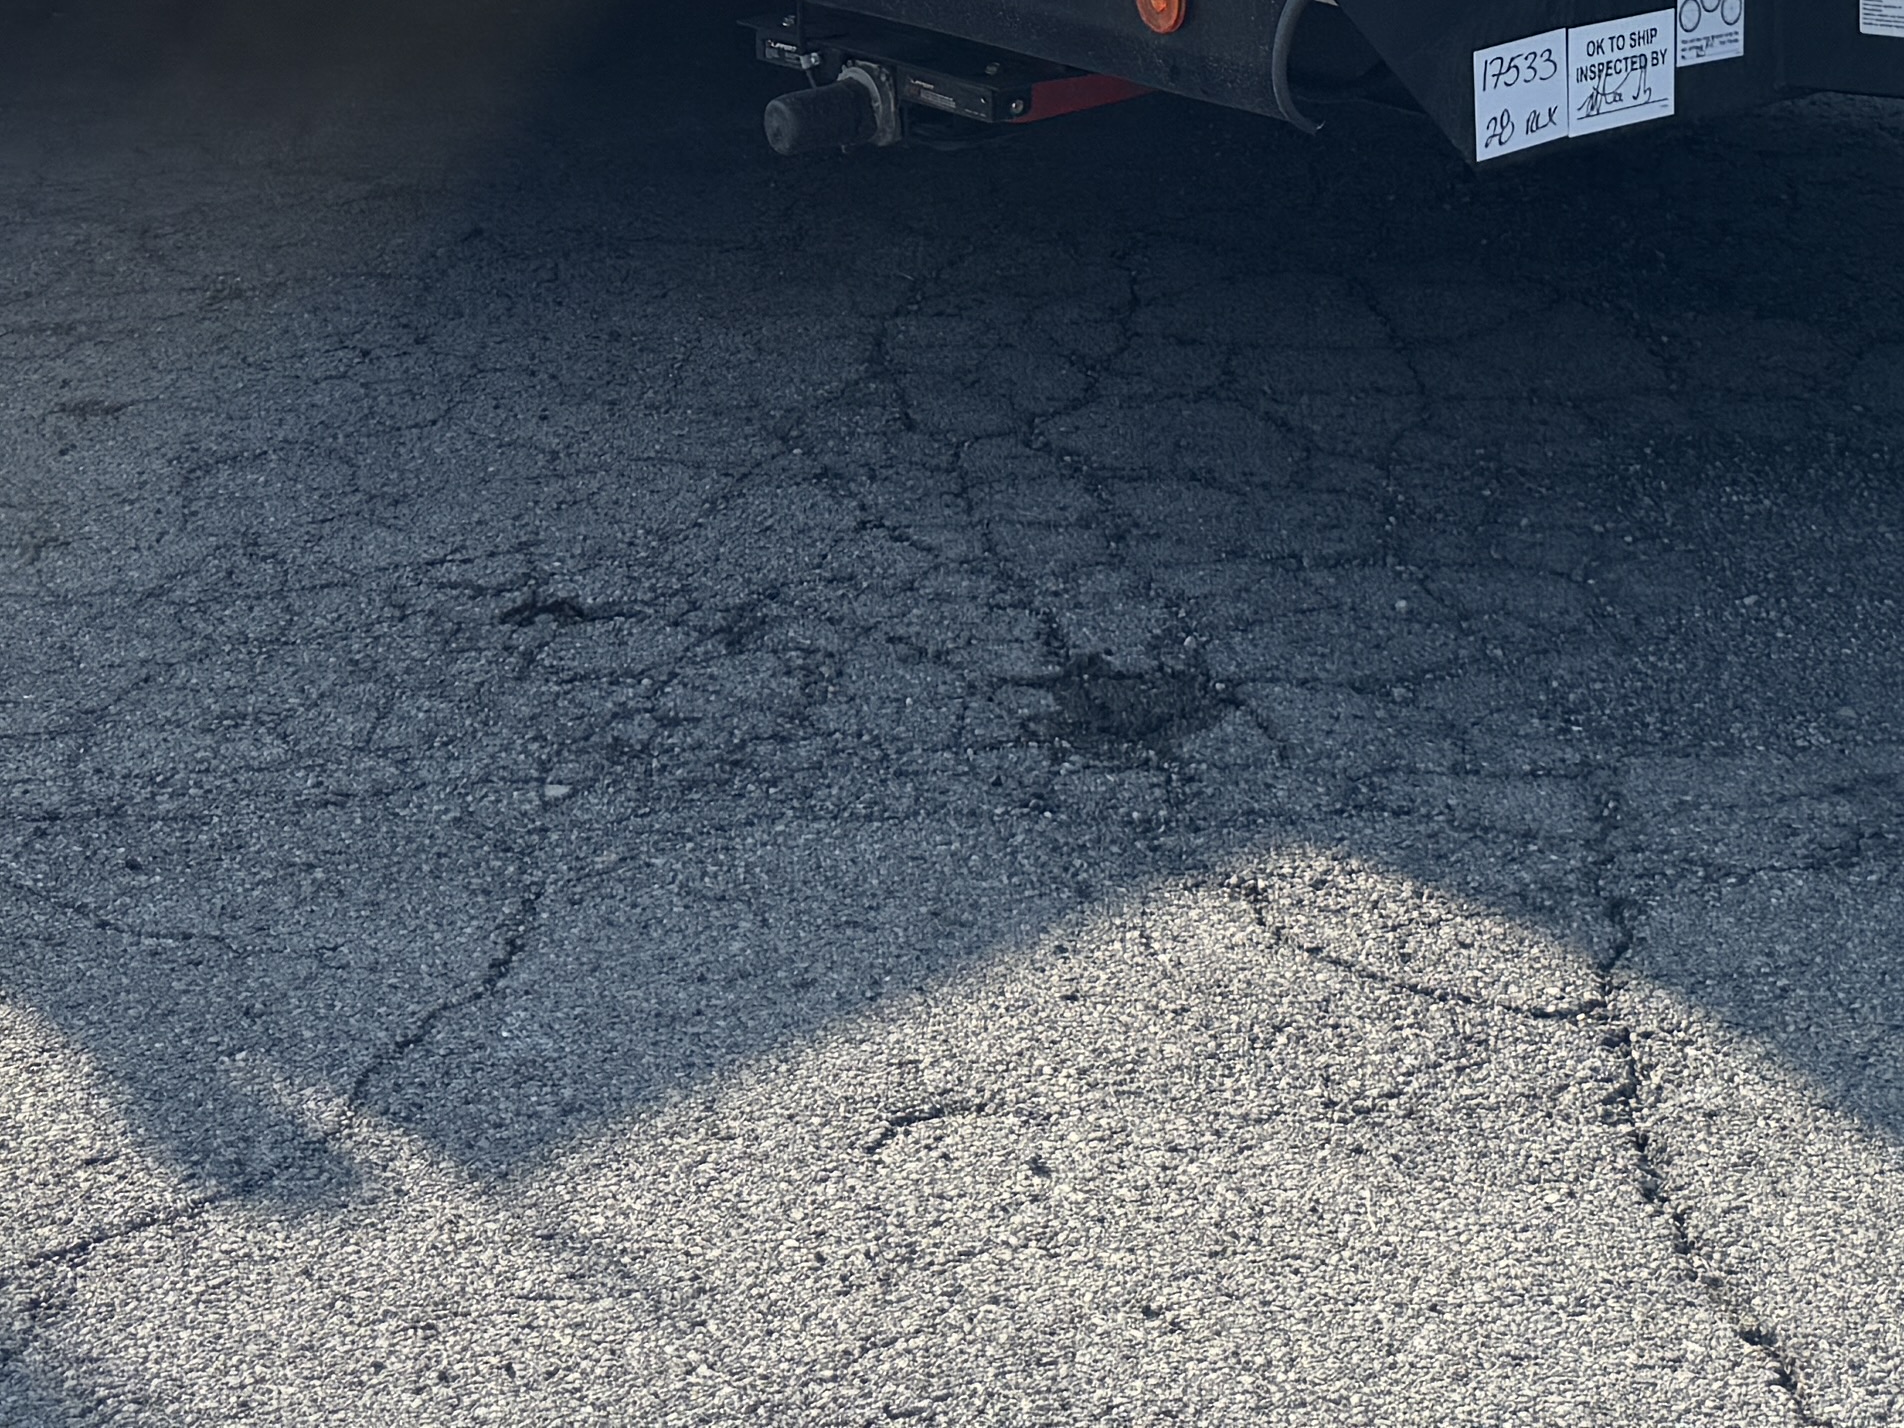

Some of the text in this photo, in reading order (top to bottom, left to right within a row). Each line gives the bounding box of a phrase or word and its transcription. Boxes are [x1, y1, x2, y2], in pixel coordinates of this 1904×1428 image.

[1586, 28, 1658, 57] OK TO SHIP
[1482, 48, 1557, 92] 17533
[1576, 48, 1667, 83] INSPECTED BY
[1485, 108, 1515, 148] 28
